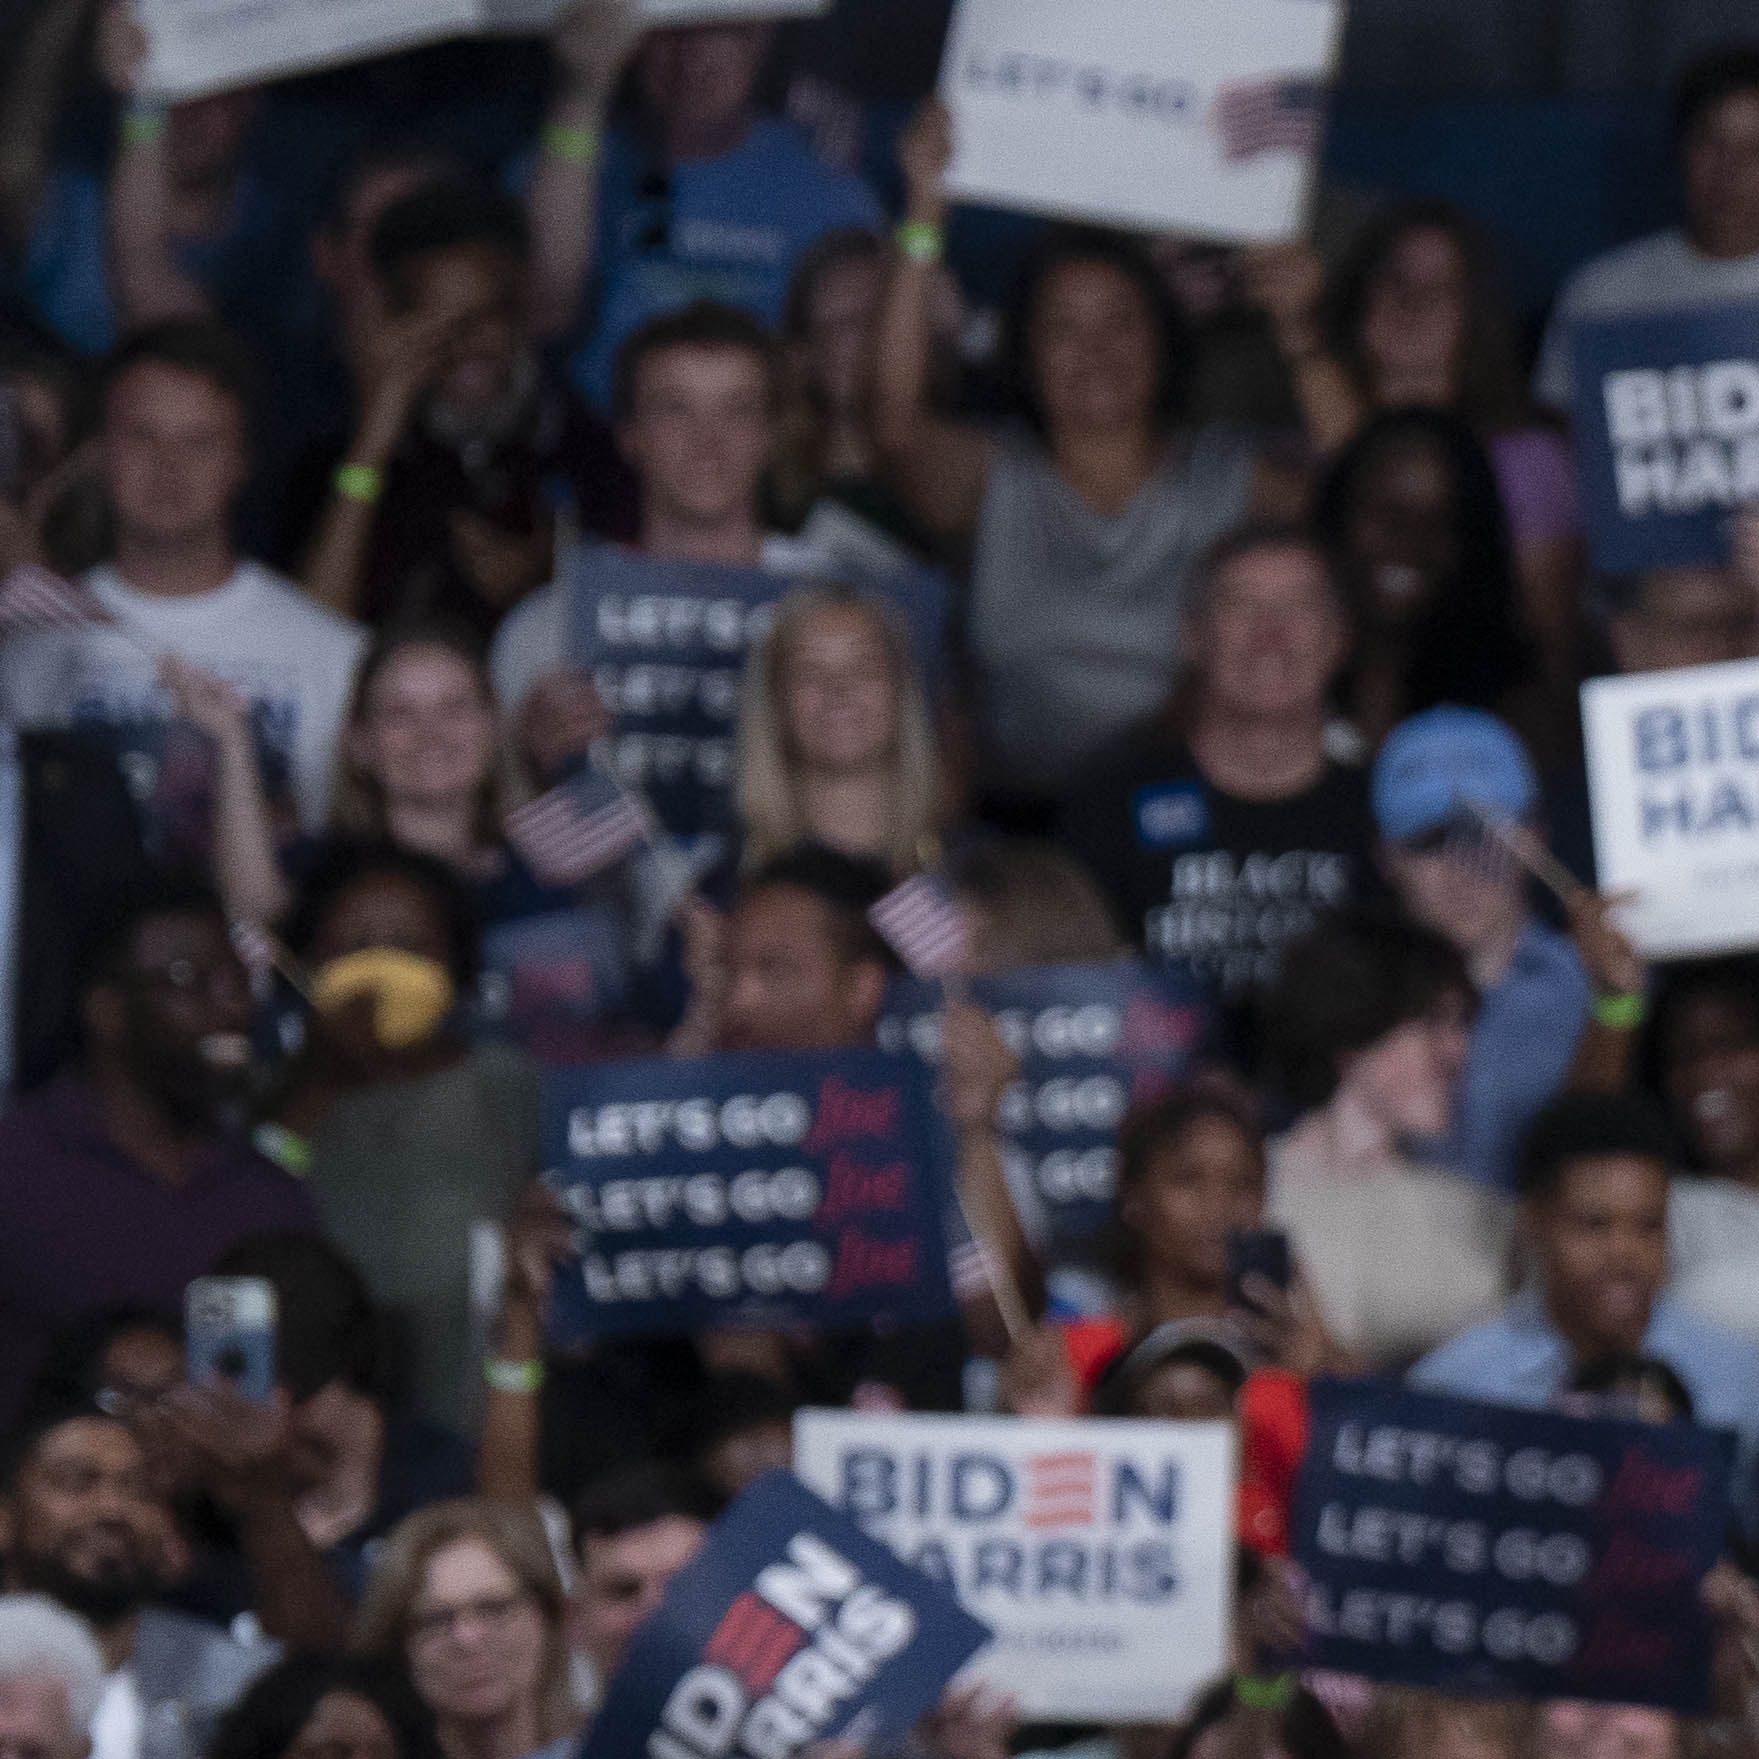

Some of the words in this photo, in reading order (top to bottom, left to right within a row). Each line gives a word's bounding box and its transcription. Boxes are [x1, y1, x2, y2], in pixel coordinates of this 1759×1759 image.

[569, 1096, 718, 1160] LET'S
[718, 1092, 813, 1151] GO
[729, 1166, 822, 1224] GO
[581, 1244, 739, 1304] LET'S
[739, 1240, 834, 1295] GO
[837, 1448, 1180, 1530] BIDEN
[1332, 1421, 1501, 1496] LET'S
[1503, 1444, 1606, 1508] GO
[910, 1538, 1178, 1606] ARRIS
[1316, 1501, 1491, 1576] LET'S
[1493, 1527, 1594, 1586] GO
[1481, 1604, 1580, 1666] GO
